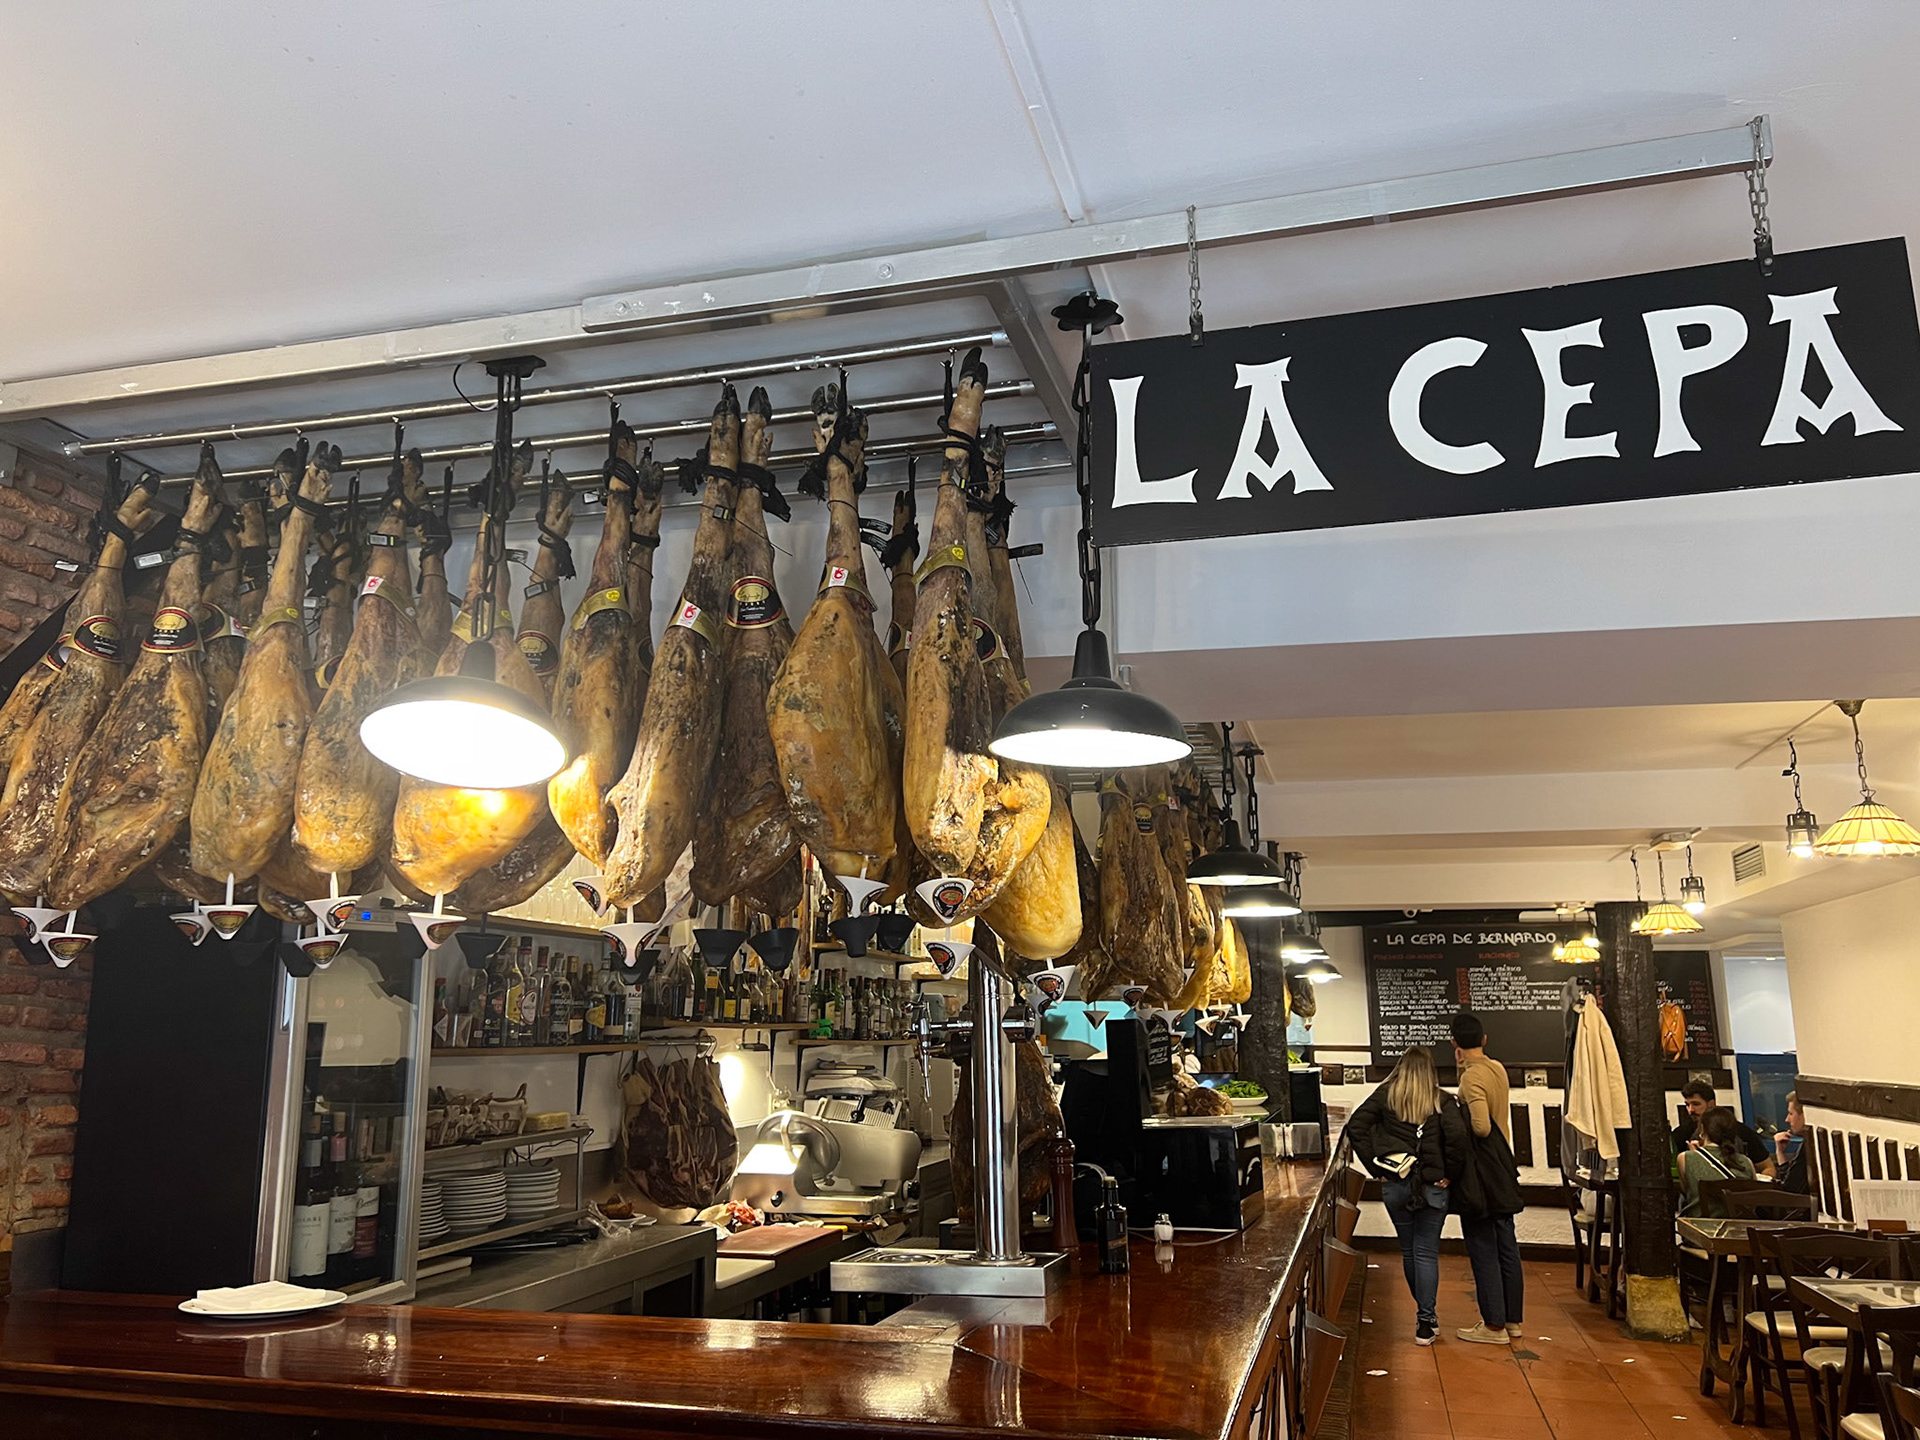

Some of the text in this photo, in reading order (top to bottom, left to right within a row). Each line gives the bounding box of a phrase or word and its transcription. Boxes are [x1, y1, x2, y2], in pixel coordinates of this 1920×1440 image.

[1109, 286, 1904, 508] LA CEPA
[1386, 931, 1557, 946] LA CEPA DE BERNARDO
